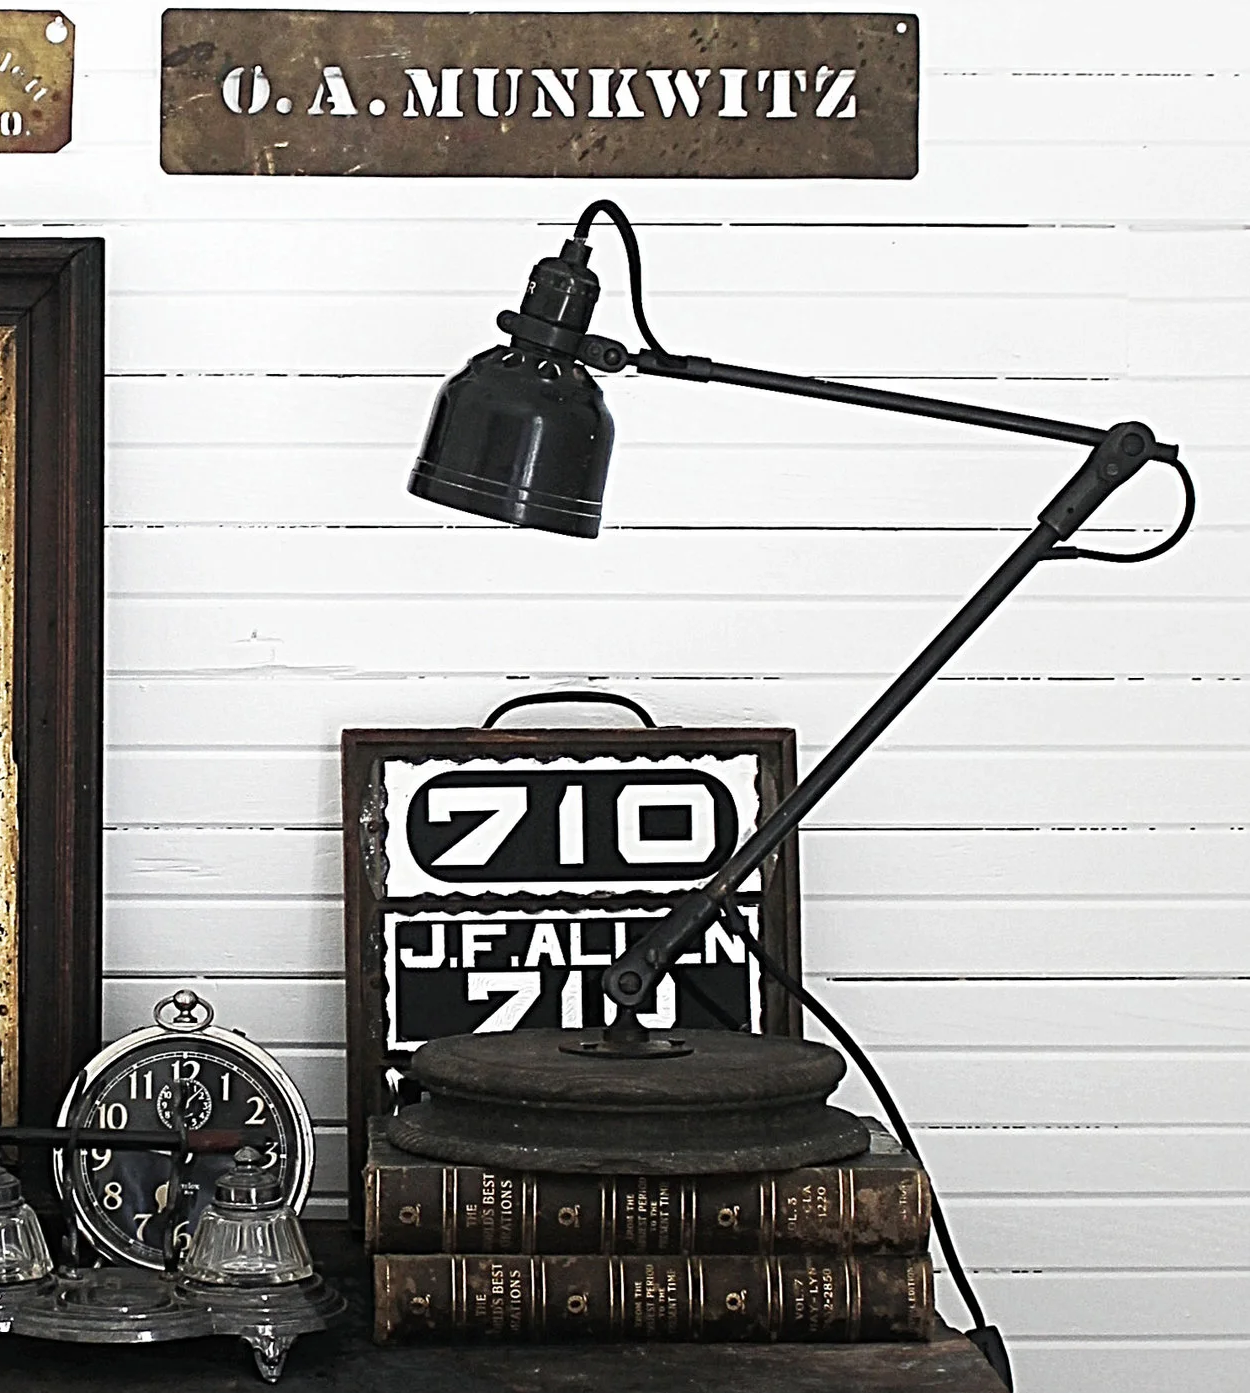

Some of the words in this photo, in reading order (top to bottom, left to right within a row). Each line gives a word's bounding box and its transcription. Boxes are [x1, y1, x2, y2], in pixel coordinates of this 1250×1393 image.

[427, 784, 716, 866] 710
[129, 1071, 153, 1100] 11
[221, 1073, 229, 1101] 1
[98, 1103, 127, 1130] 10
[245, 1097, 267, 1125] 2
[103, 1182, 122, 1209] 8
[483, 1174, 495, 1204] BEST
[638, 1177, 647, 1212] PERIOD
[467, 1204, 476, 1227] THE
[501, 1180, 512, 1246] ORATIONS
[133, 1214, 152, 1241] 7
[492, 1264, 504, 1294] BEST
[646, 1264, 654, 1298] PERIOD
[476, 1294, 486, 1315] THE
